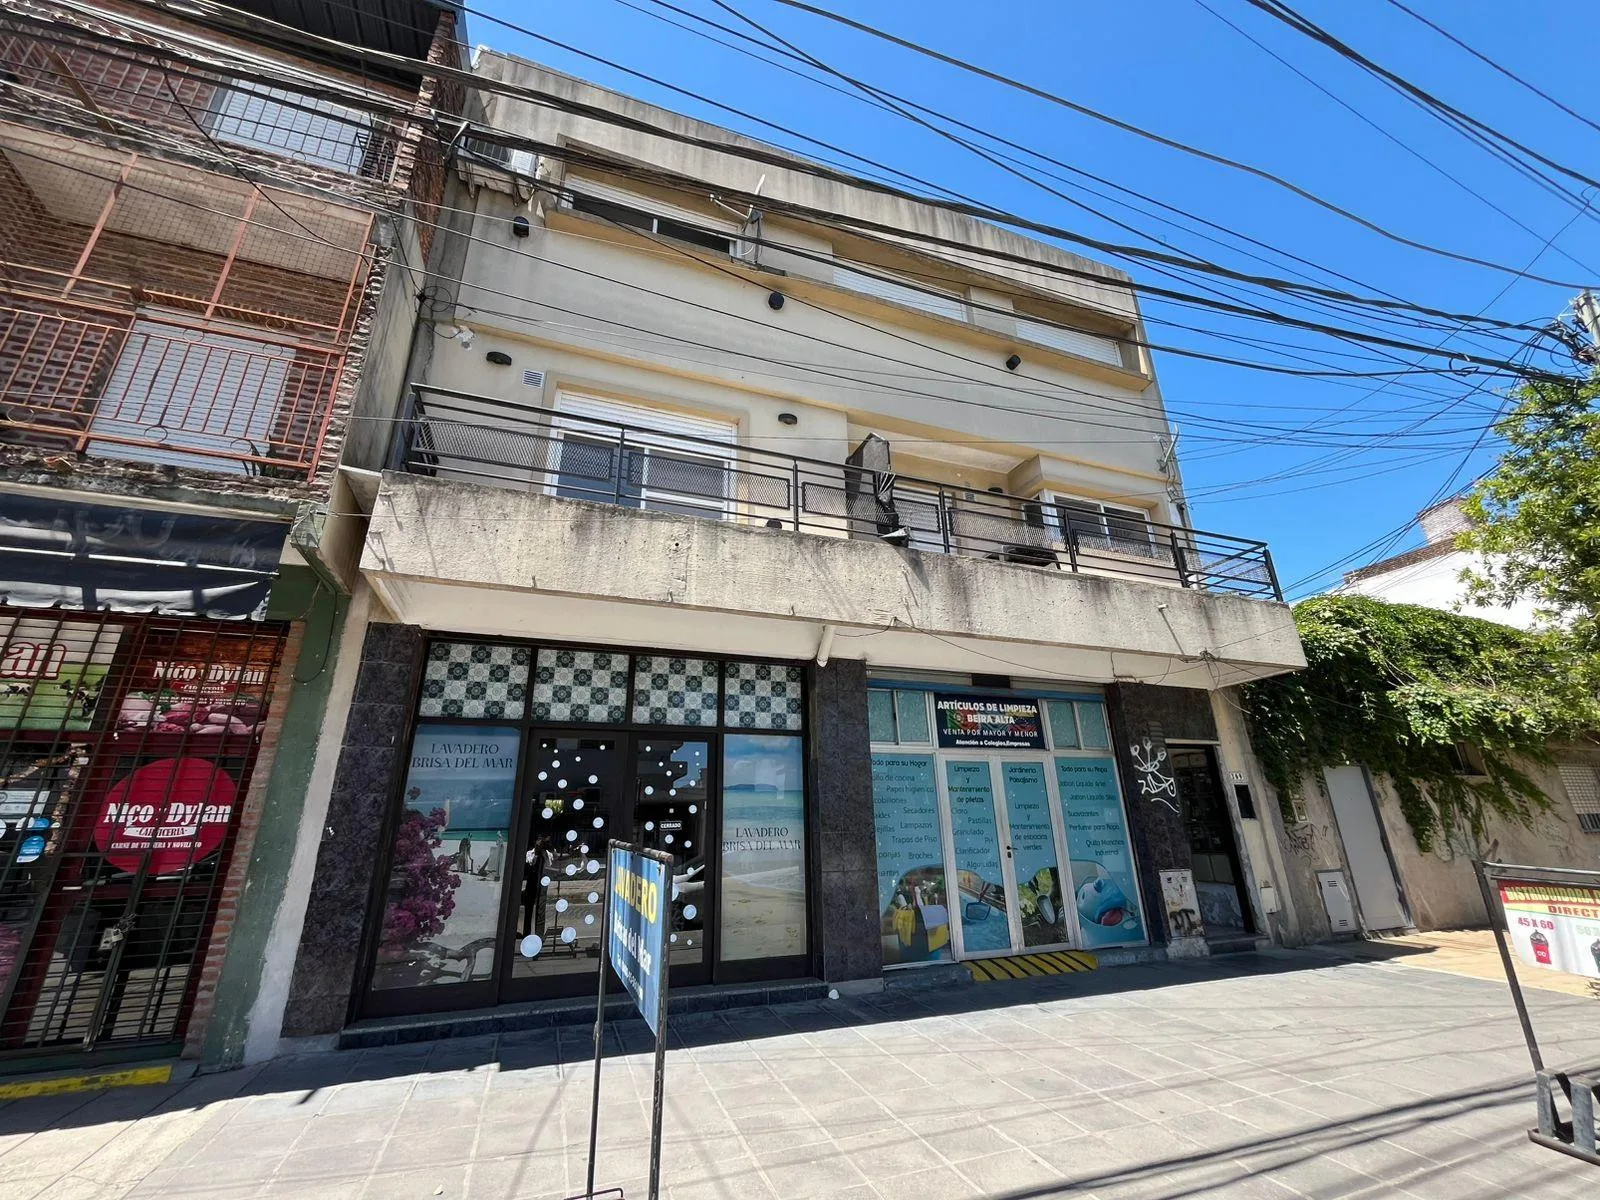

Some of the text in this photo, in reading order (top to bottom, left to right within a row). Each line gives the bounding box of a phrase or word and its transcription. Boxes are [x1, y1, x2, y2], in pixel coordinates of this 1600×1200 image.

[152, 661, 196, 680] Nico
[207, 663, 265, 685] Dylan
[937, 699, 1038, 713] ARTÍCULOS DE LIMPIEZA
[995, 715, 1015, 724] ALTA
[983, 729, 1006, 737] MAYOR
[431, 742, 499, 754] LAVADERO
[411, 757, 513, 768] BRISA DEL MAR
[103, 802, 155, 824] Nico
[165, 803, 232, 826] Dylan
[138, 827, 186, 836] CARICERIA
[735, 827, 789, 838] LAVADERO
[722, 839, 801, 852] BRISA DEL MAR
[1517, 917, 1530, 926] 45
[1539, 919, 1554, 930] 60
